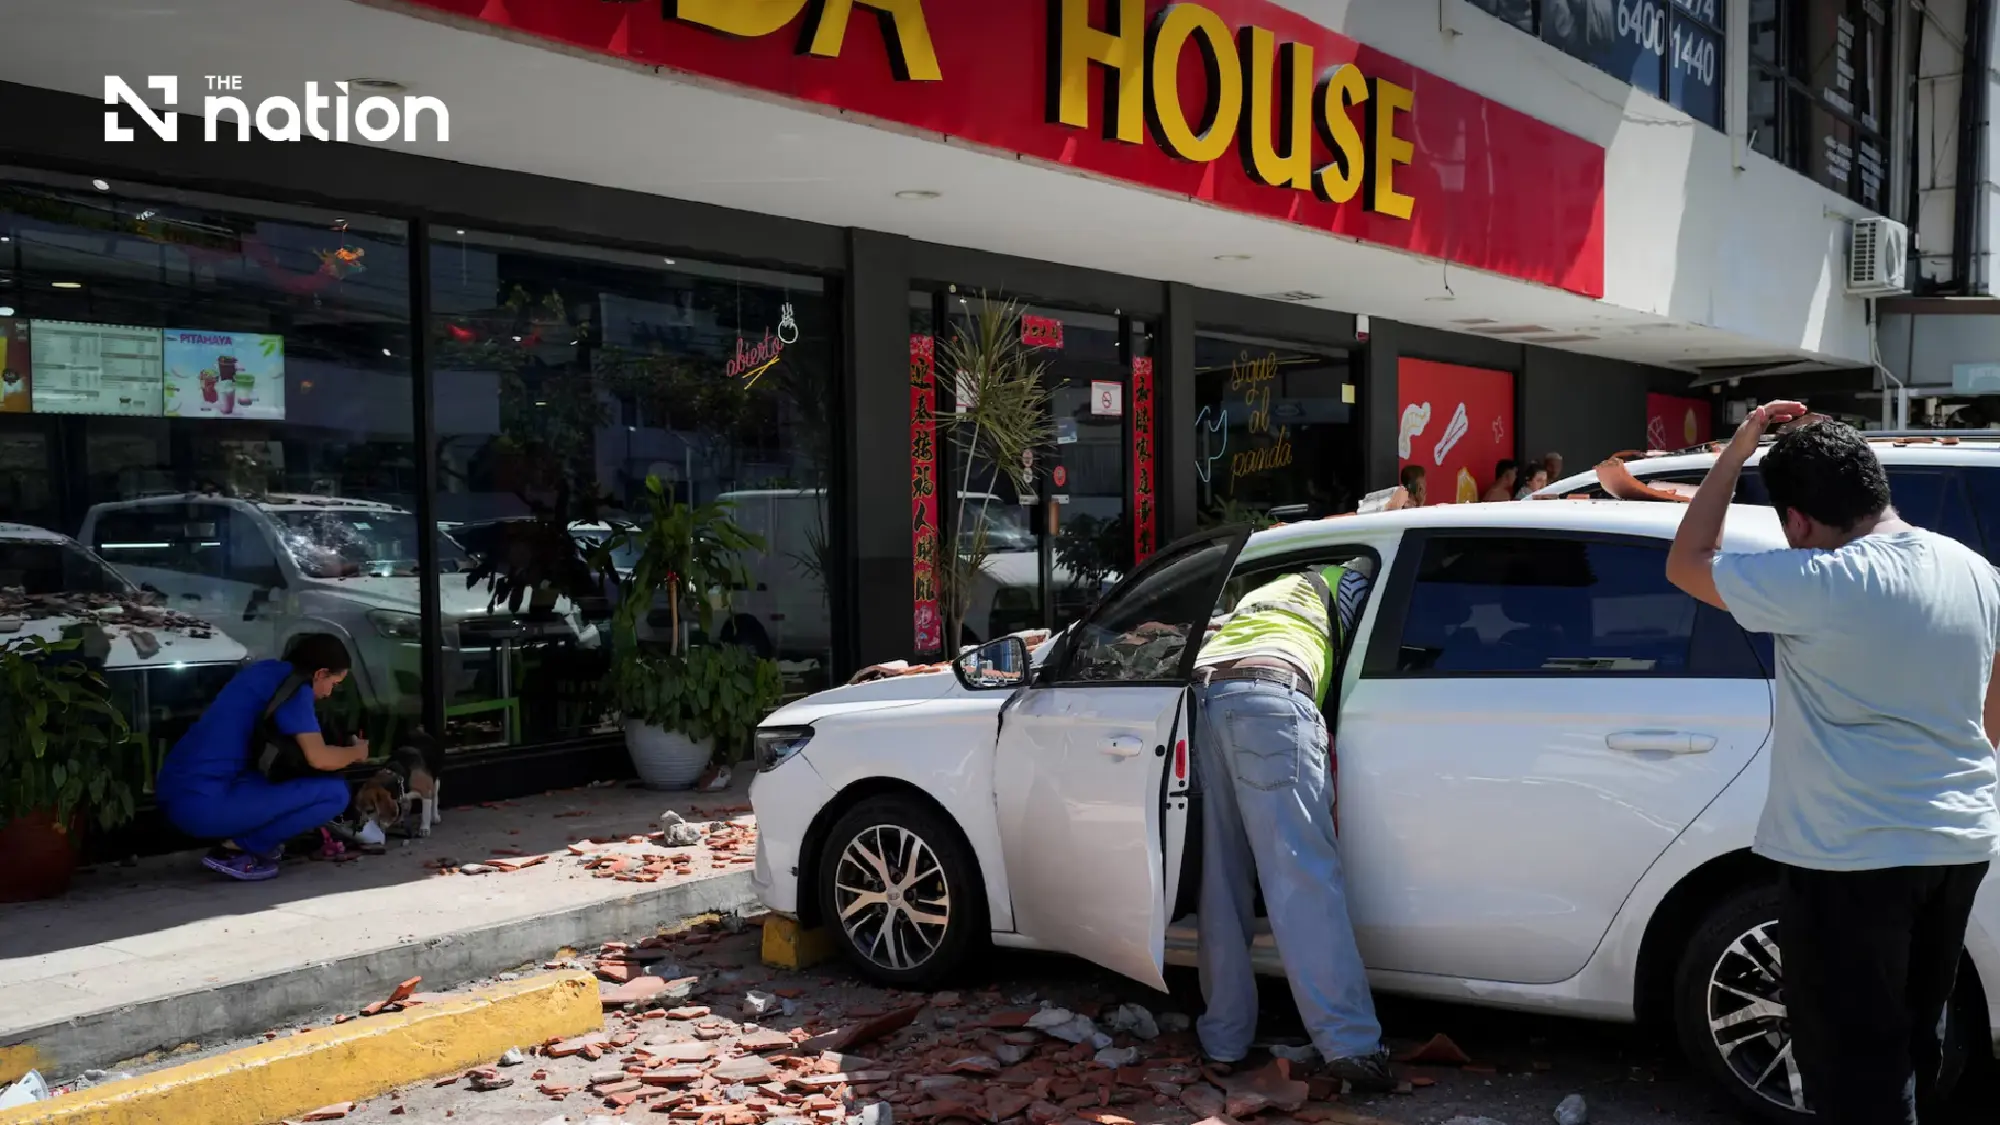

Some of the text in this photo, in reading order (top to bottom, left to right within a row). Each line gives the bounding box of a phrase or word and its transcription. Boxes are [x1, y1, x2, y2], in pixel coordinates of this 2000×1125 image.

[1617, 0, 1666, 56] 6400
[1672, 23, 1715, 87] 1440
[1048, 0, 1416, 221] HOUSE
[179, 332, 233, 347] PITAHAYA
[726, 326, 785, 377] abierto
[1230, 350, 1279, 406] sigue
[1249, 386, 1272, 434] al
[1230, 424, 1293, 495] panda
